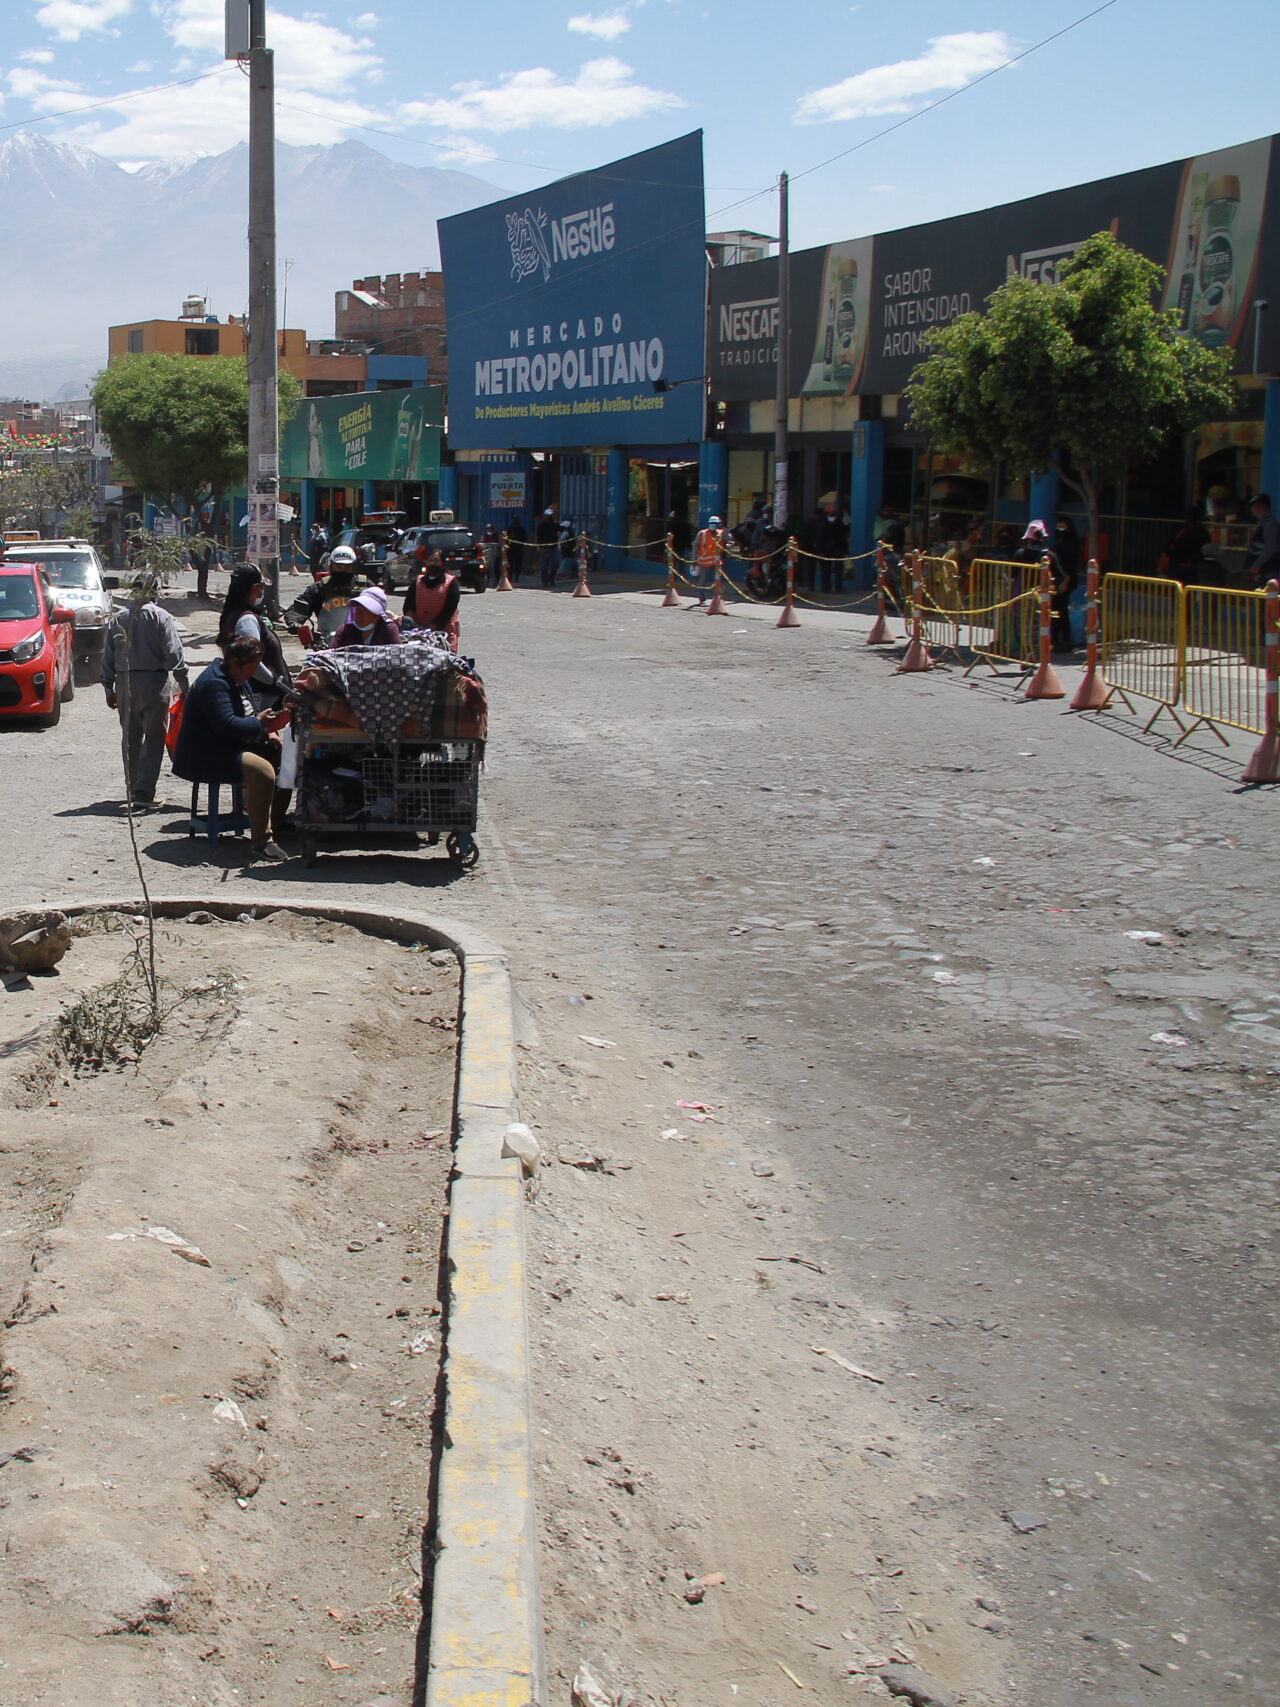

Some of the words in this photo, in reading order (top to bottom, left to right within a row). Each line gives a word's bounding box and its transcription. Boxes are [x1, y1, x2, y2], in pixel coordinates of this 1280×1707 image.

[552, 202, 615, 263] Nestlé
[884, 268, 931, 298] SABOR
[720, 298, 780, 342] NESCAF
[884, 293, 970, 328] INTENSIDAD
[510, 313, 622, 348] MERCADO
[475, 337, 664, 396] METROPOLITANO
[720, 344, 779, 366] TRADICIÓ
[338, 402, 372, 432] ENERGÍA
[475, 406, 484, 420] De
[485, 404, 528, 419] Productores
[530, 403, 570, 418] Mayoristas
[572, 400, 600, 414] Andrés
[602, 396, 631, 412] Avelino
[633, 395, 664, 410] Cáceres
[345, 436, 366, 457] PARA
[349, 450, 368, 470] COLE
[492, 482, 524, 490] PUERTA
[492, 500, 524, 508] SALIDA
[324, 598, 348, 612] POL
